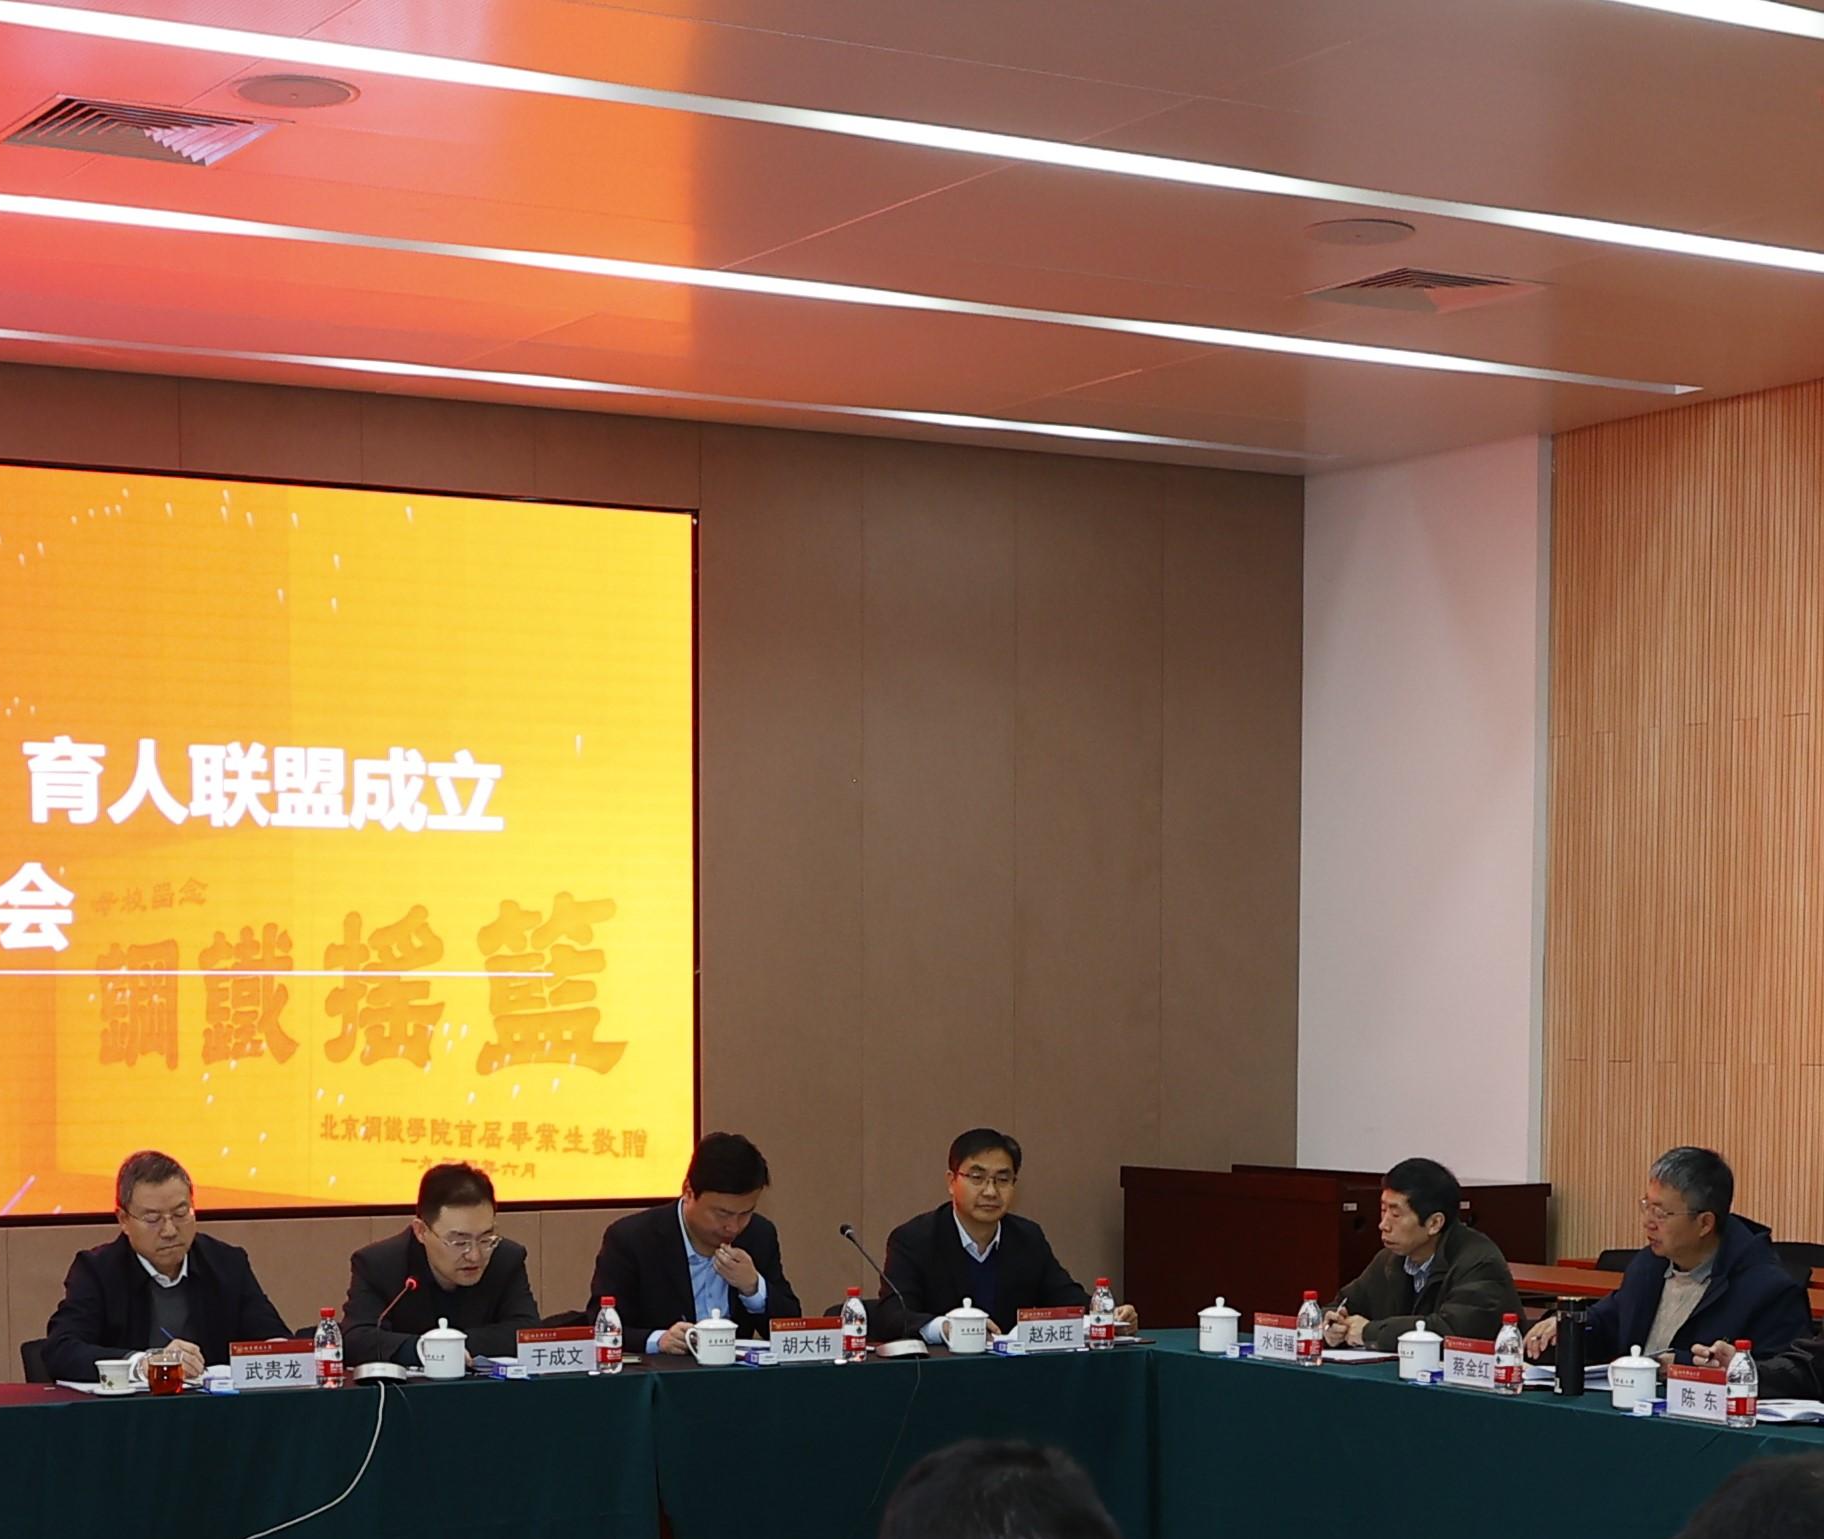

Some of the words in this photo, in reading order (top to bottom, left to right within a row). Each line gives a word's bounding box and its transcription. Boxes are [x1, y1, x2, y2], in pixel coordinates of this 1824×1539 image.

[1029, 1325, 1073, 1343] 赵永旺
[782, 1335, 831, 1354] 胡大伟
[531, 1347, 583, 1367] 于成文
[245, 1360, 303, 1380] 武贵龙
[1453, 1357, 1489, 1380] 蔡金红
